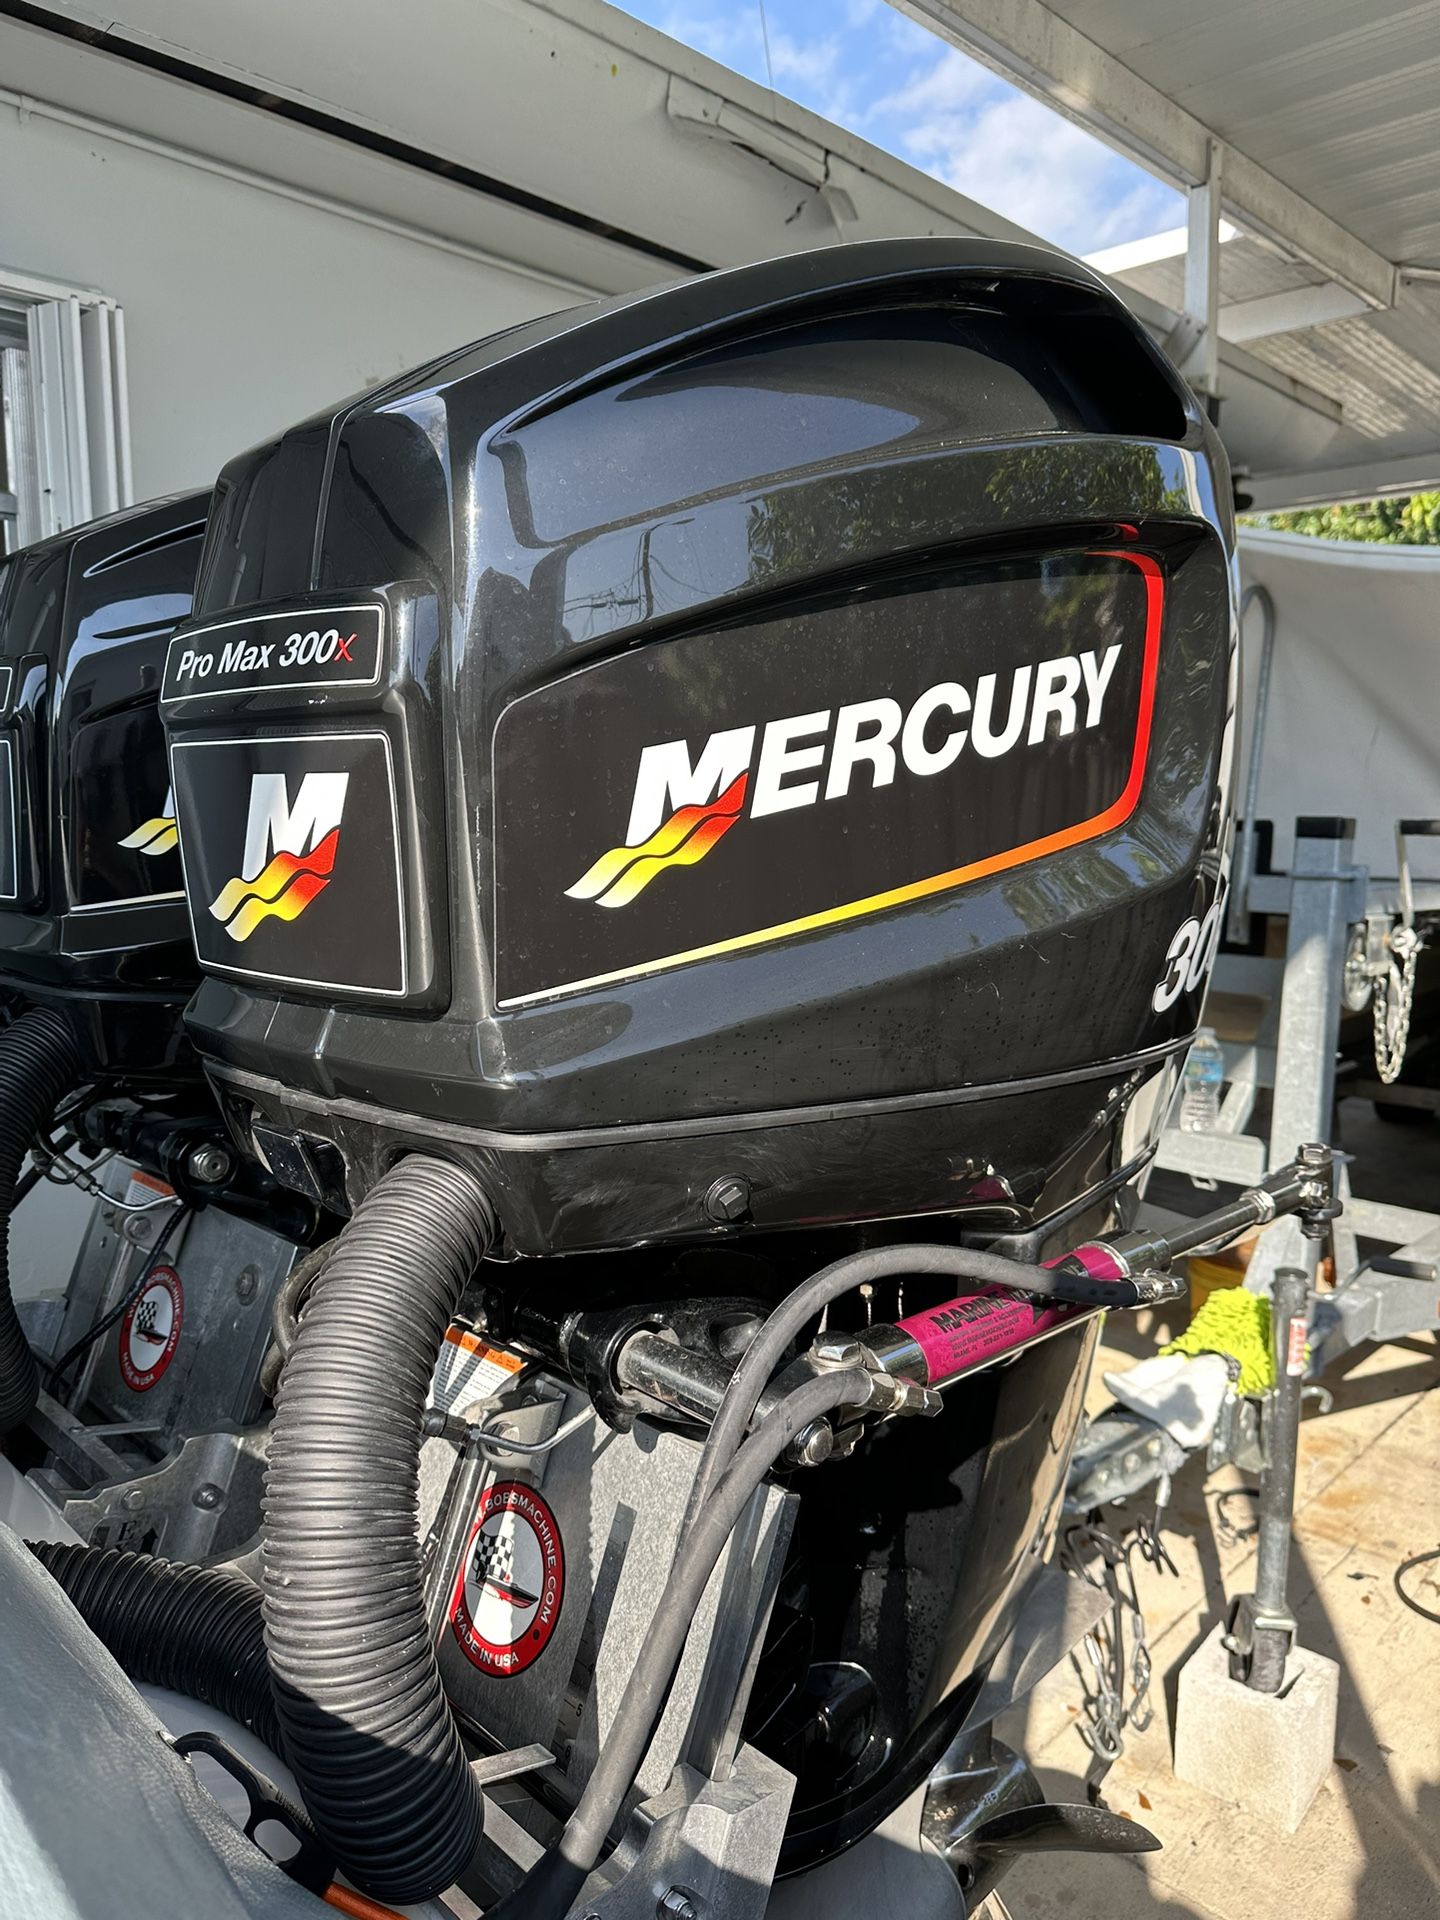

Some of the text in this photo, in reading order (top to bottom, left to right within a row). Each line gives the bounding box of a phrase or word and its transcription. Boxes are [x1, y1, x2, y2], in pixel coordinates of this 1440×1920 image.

[176, 649, 212, 682] Pro
[217, 639, 276, 675] Max
[625, 644, 1122, 847] MERCURY
[242, 772, 350, 882] M
[1152, 901, 1221, 1014] 30
[474, 1491, 558, 1625] W.BOBSMACHINE.COM
[454, 1606, 520, 1668] MADE IN USA
[575, 1703, 583, 1717] 5
